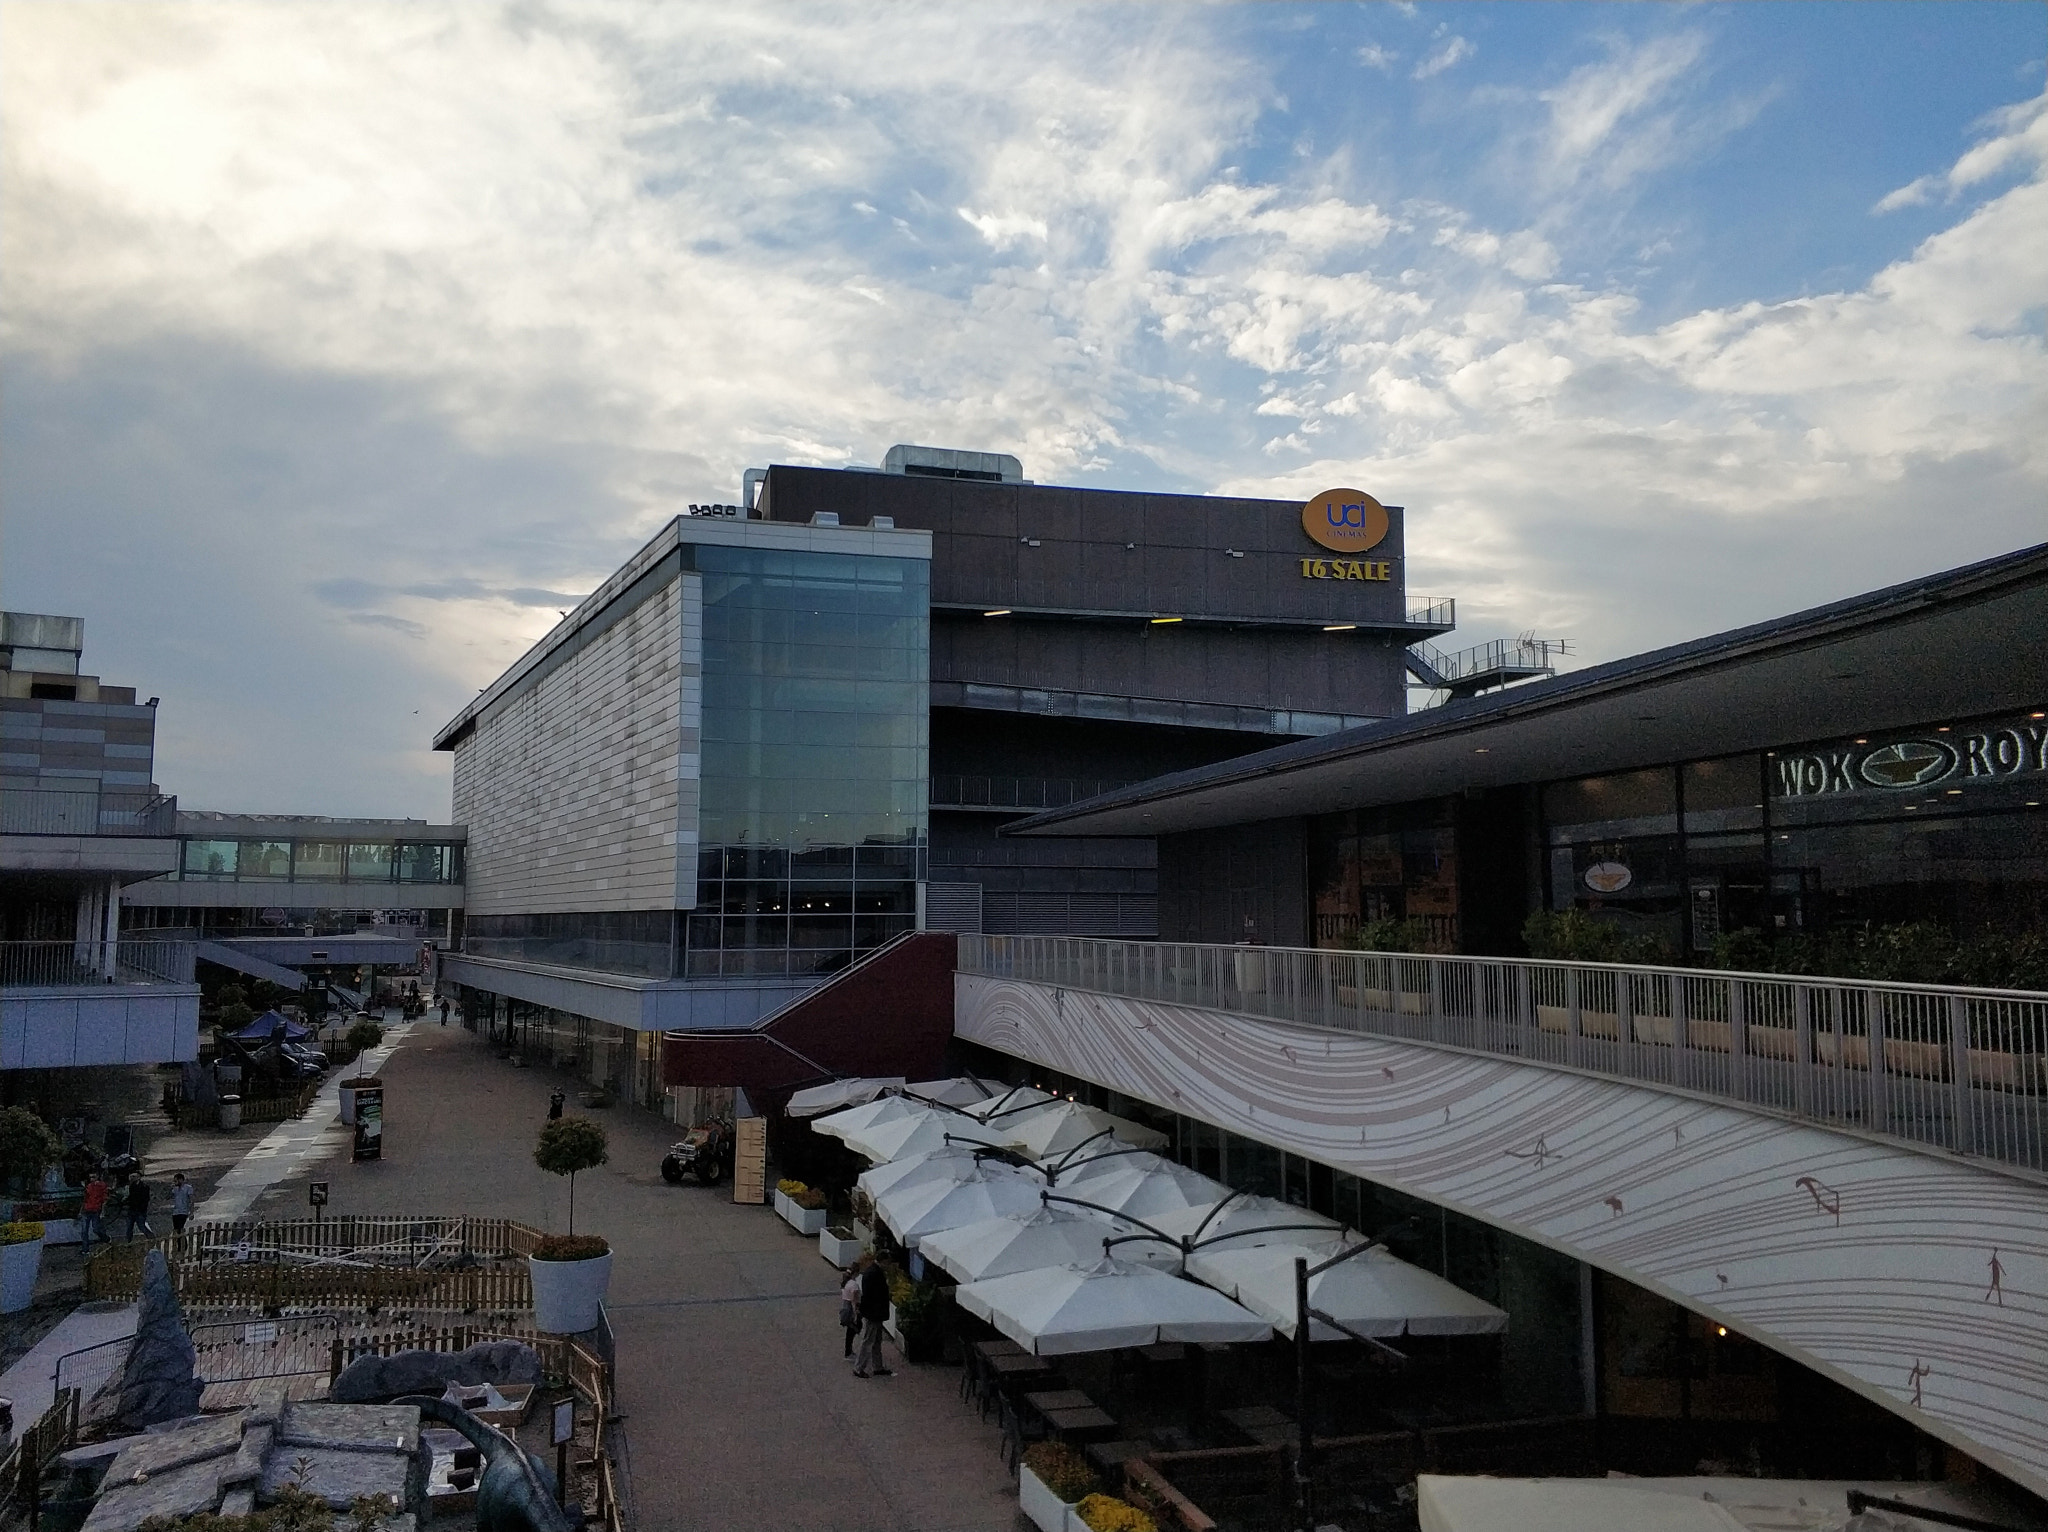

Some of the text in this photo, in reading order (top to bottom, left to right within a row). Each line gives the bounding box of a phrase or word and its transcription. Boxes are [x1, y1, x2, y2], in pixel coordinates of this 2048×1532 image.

[1326, 530, 1367, 539] CINEMAS
[1301, 558, 1391, 581] 16 SALE
[1777, 753, 1854, 797] WOK
